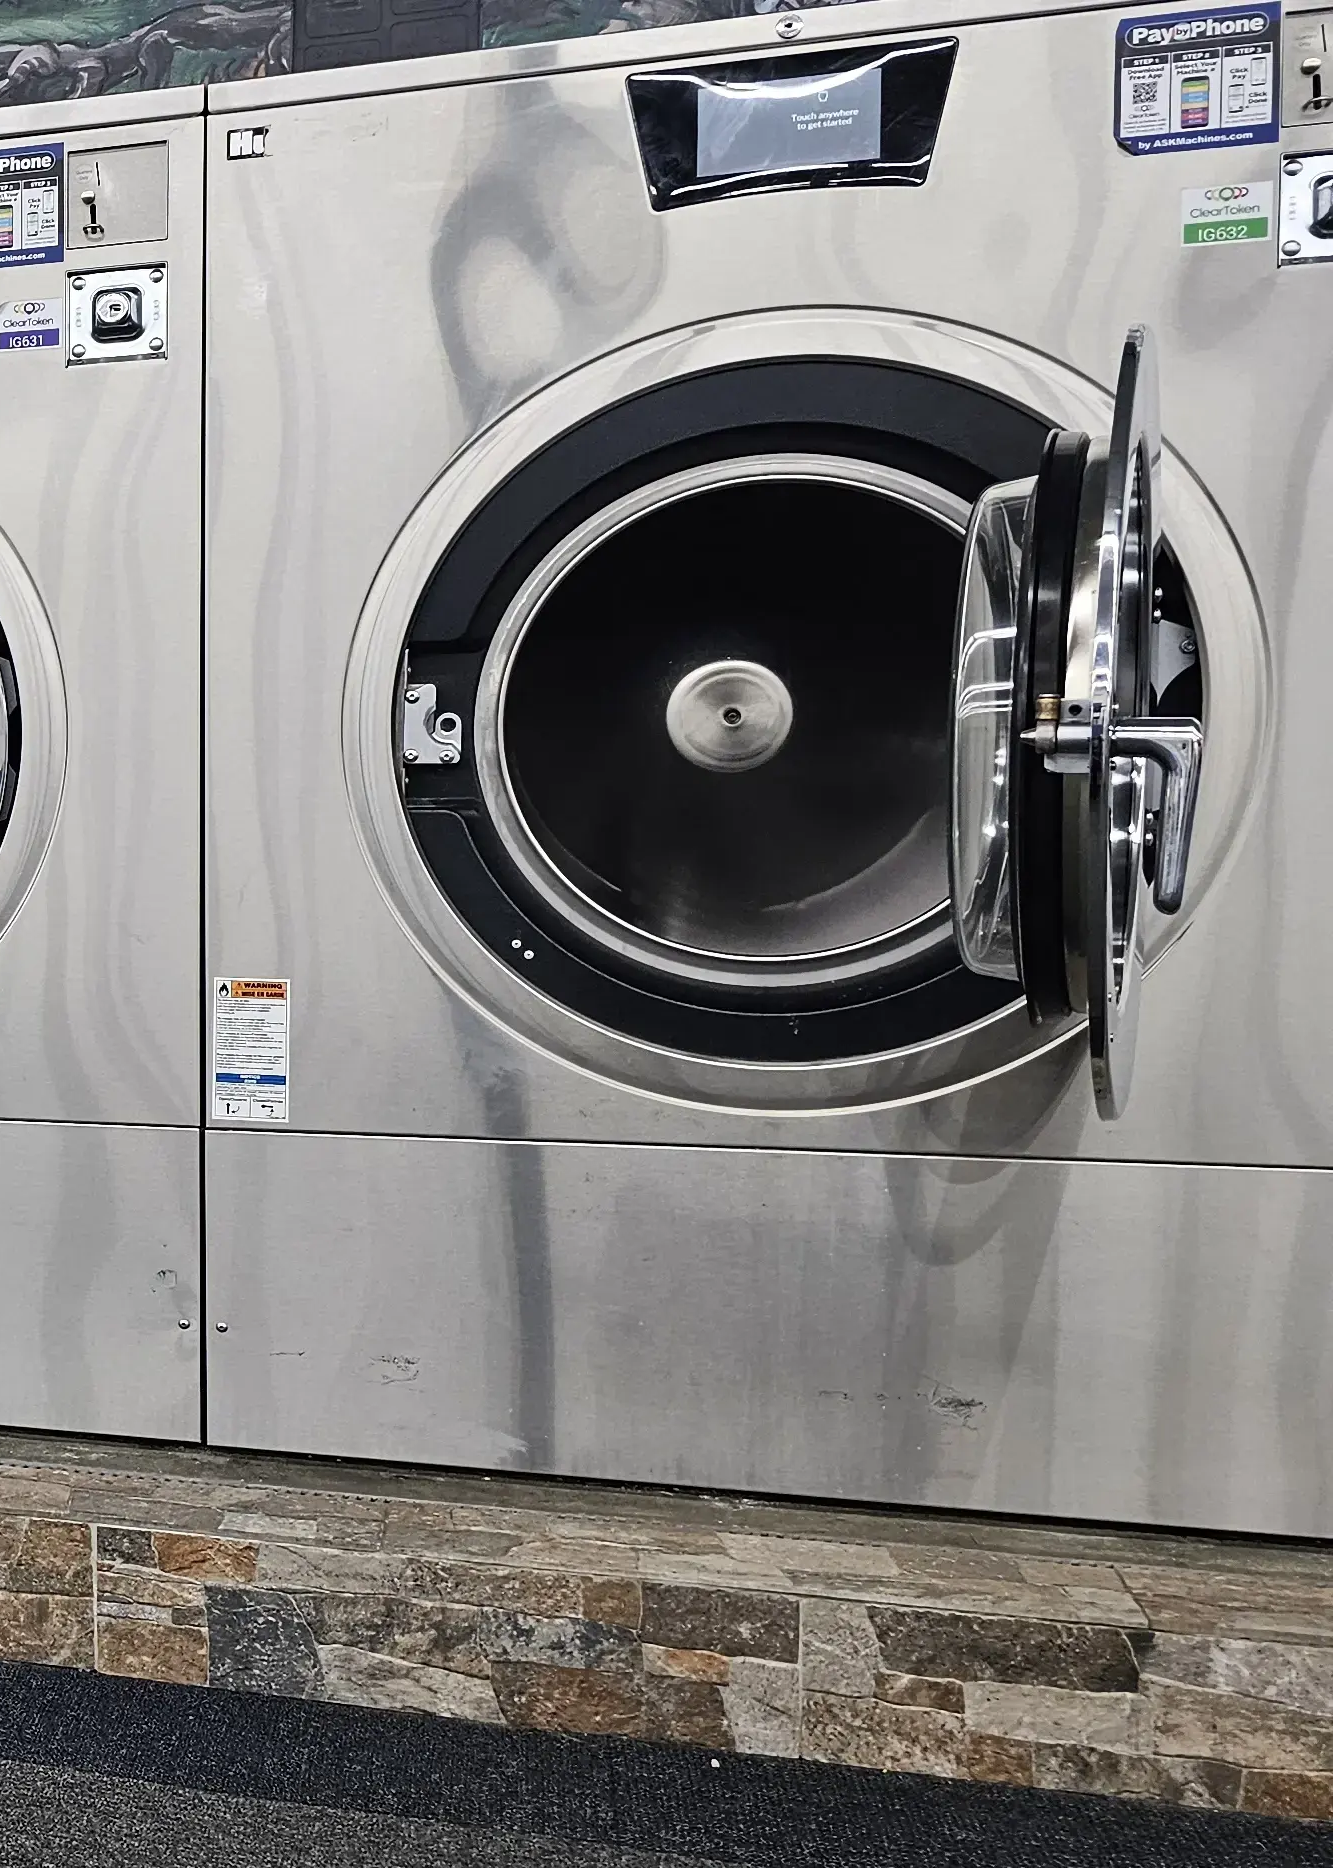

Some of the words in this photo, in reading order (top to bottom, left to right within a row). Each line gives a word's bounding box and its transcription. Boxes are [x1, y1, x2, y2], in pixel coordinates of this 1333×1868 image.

[1132, 27, 1173, 45] Pay
[1176, 27, 1188, 36] by
[1190, 17, 1265, 38] Phone
[1182, 52, 1204, 60] STEP
[1233, 47, 1256, 55] STEP
[1133, 58, 1156, 66] STEP
[1127, 66, 1165, 75] Download
[791, 112, 817, 122] Touch
[818, 109, 859, 119] anywhere
[807, 121, 821, 130] get
[822, 117, 853, 127] started
[1138, 141, 1150, 149] by
[1152, 132, 1254, 148] ASKMachines.com
[1190, 203, 1261, 218] ClearToken
[1198, 225, 1248, 242] IG632
[3, 316, 54, 329] ClearToken
[8, 335, 44, 348] IG631
